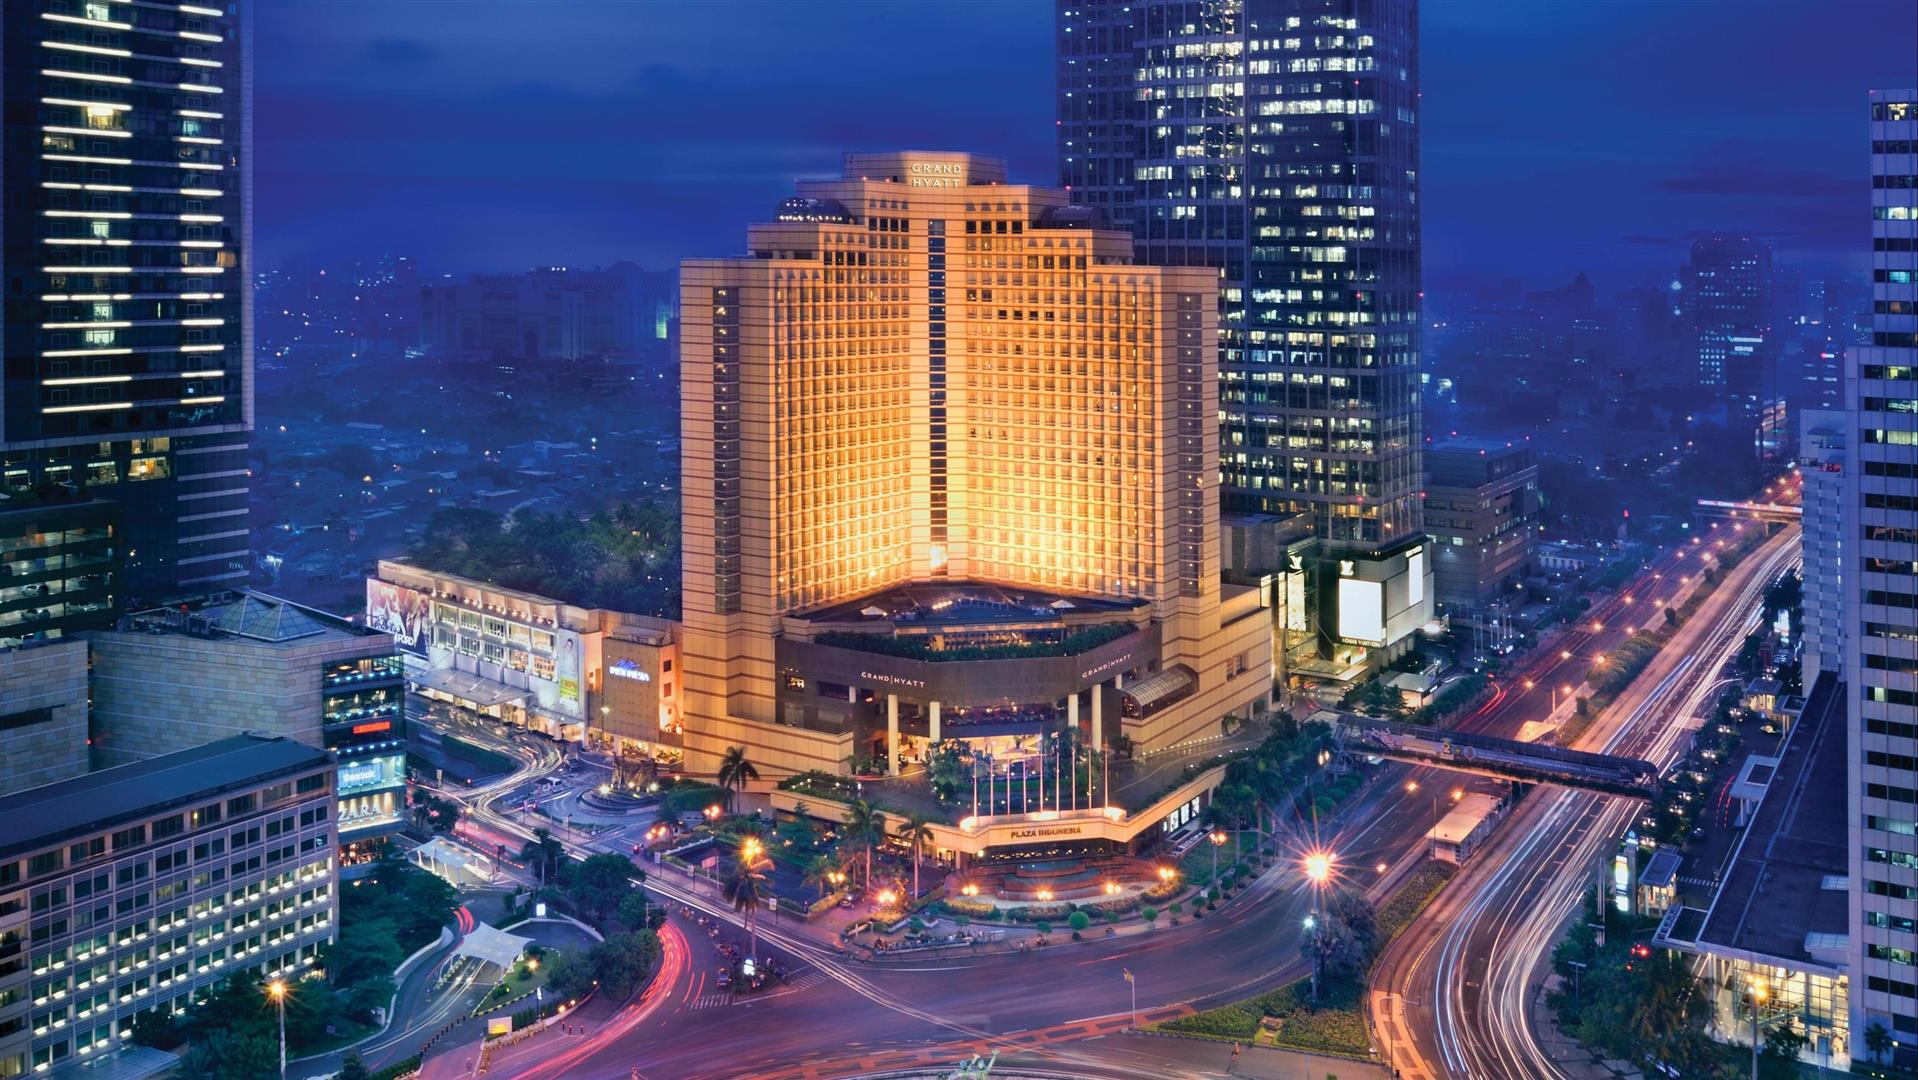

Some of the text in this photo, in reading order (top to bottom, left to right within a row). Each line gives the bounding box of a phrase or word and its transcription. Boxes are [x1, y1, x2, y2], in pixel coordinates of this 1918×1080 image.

[911, 163, 962, 173] GRAND
[912, 178, 961, 188] HYATT
[1082, 654, 1131, 678] GRAND HYATT
[861, 671, 925, 688] GRAND HYATT
[343, 770, 377, 783] Reebok
[338, 804, 384, 821] ZARA
[1010, 827, 1082, 838] PLAZA INDONESIA
